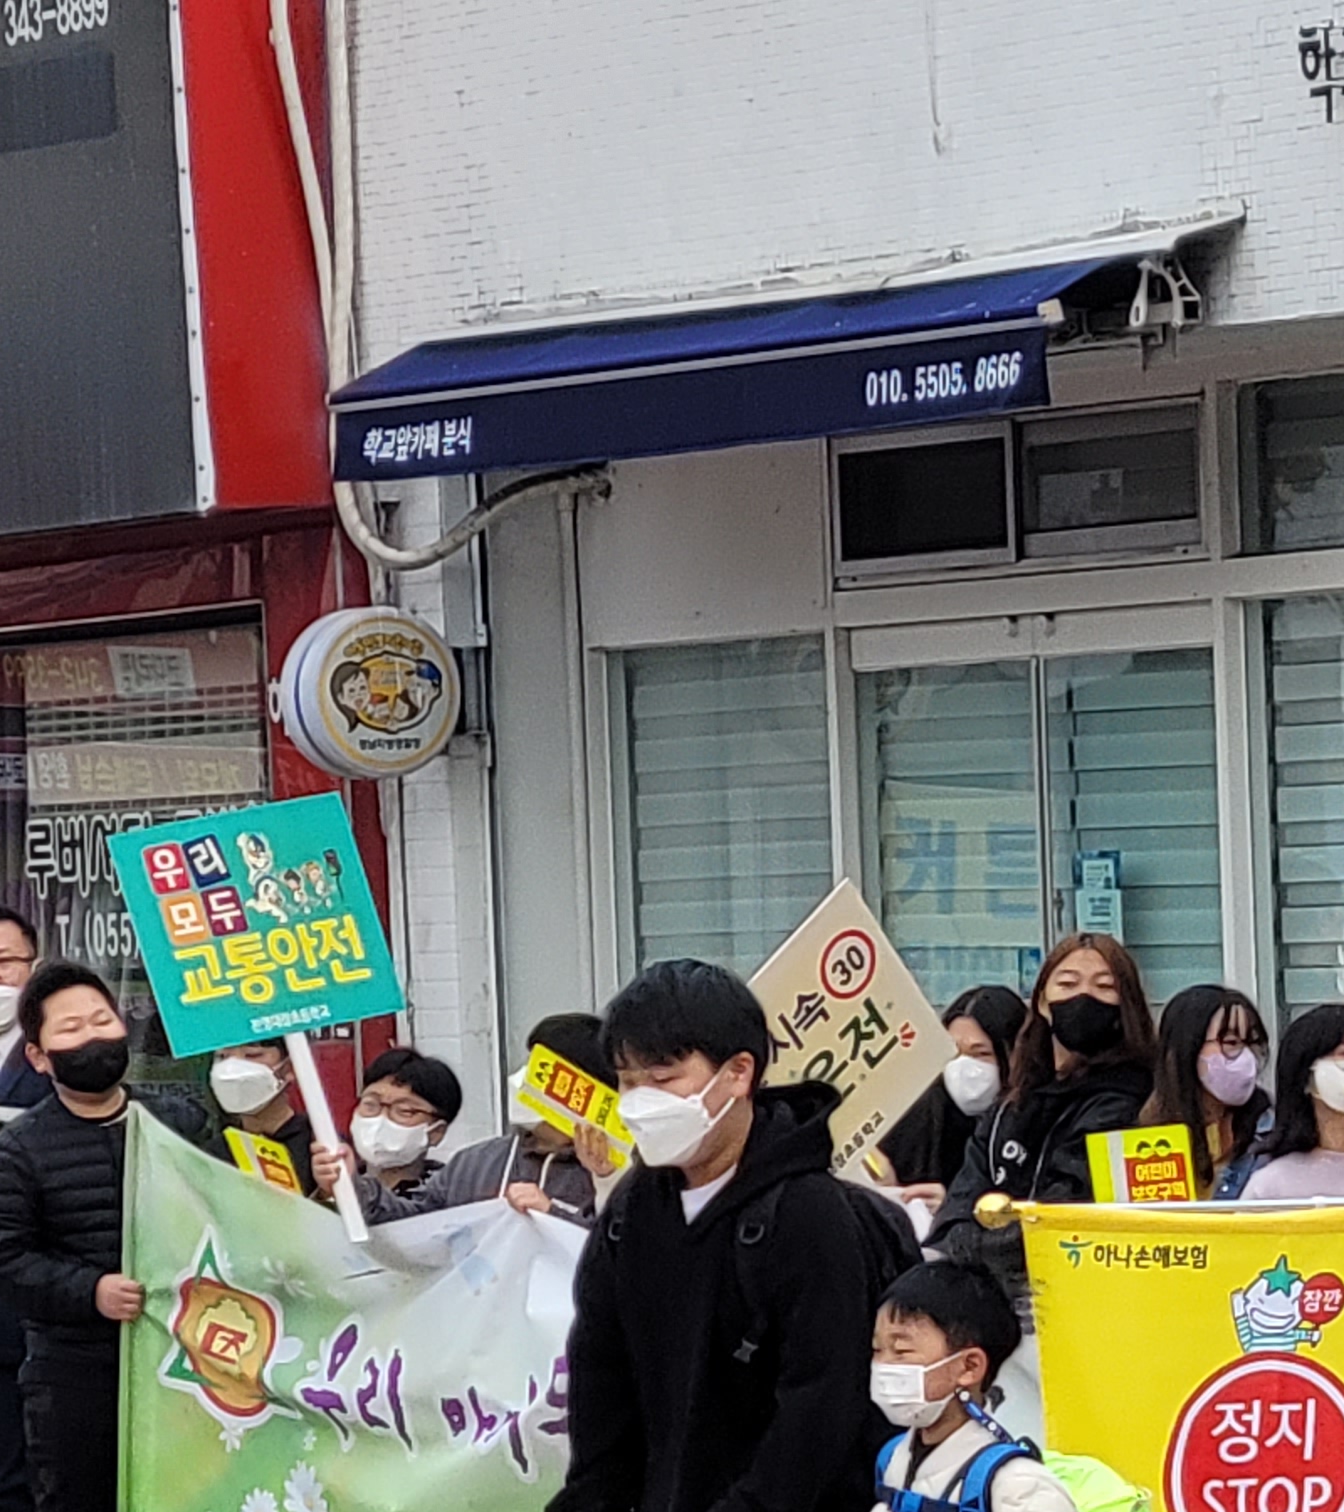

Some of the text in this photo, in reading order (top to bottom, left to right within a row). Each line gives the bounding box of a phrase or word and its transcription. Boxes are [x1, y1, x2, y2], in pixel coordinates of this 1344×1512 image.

[865, 350, 1024, 407] 010. 5505. 8666
[362, 415, 473, 467] 학교앞카페 분식
[152, 835, 230, 889] 우리
[169, 890, 245, 937] 모두
[173, 913, 373, 1005] 교통안전
[768, 944, 866, 1065] 시속 30
[1131, 1180, 1187, 1202] 보호구역
[1134, 1160, 1178, 1183] 어린이
[1303, 1288, 1344, 1313] 잠깐
[1210, 1397, 1317, 1464] 정지
